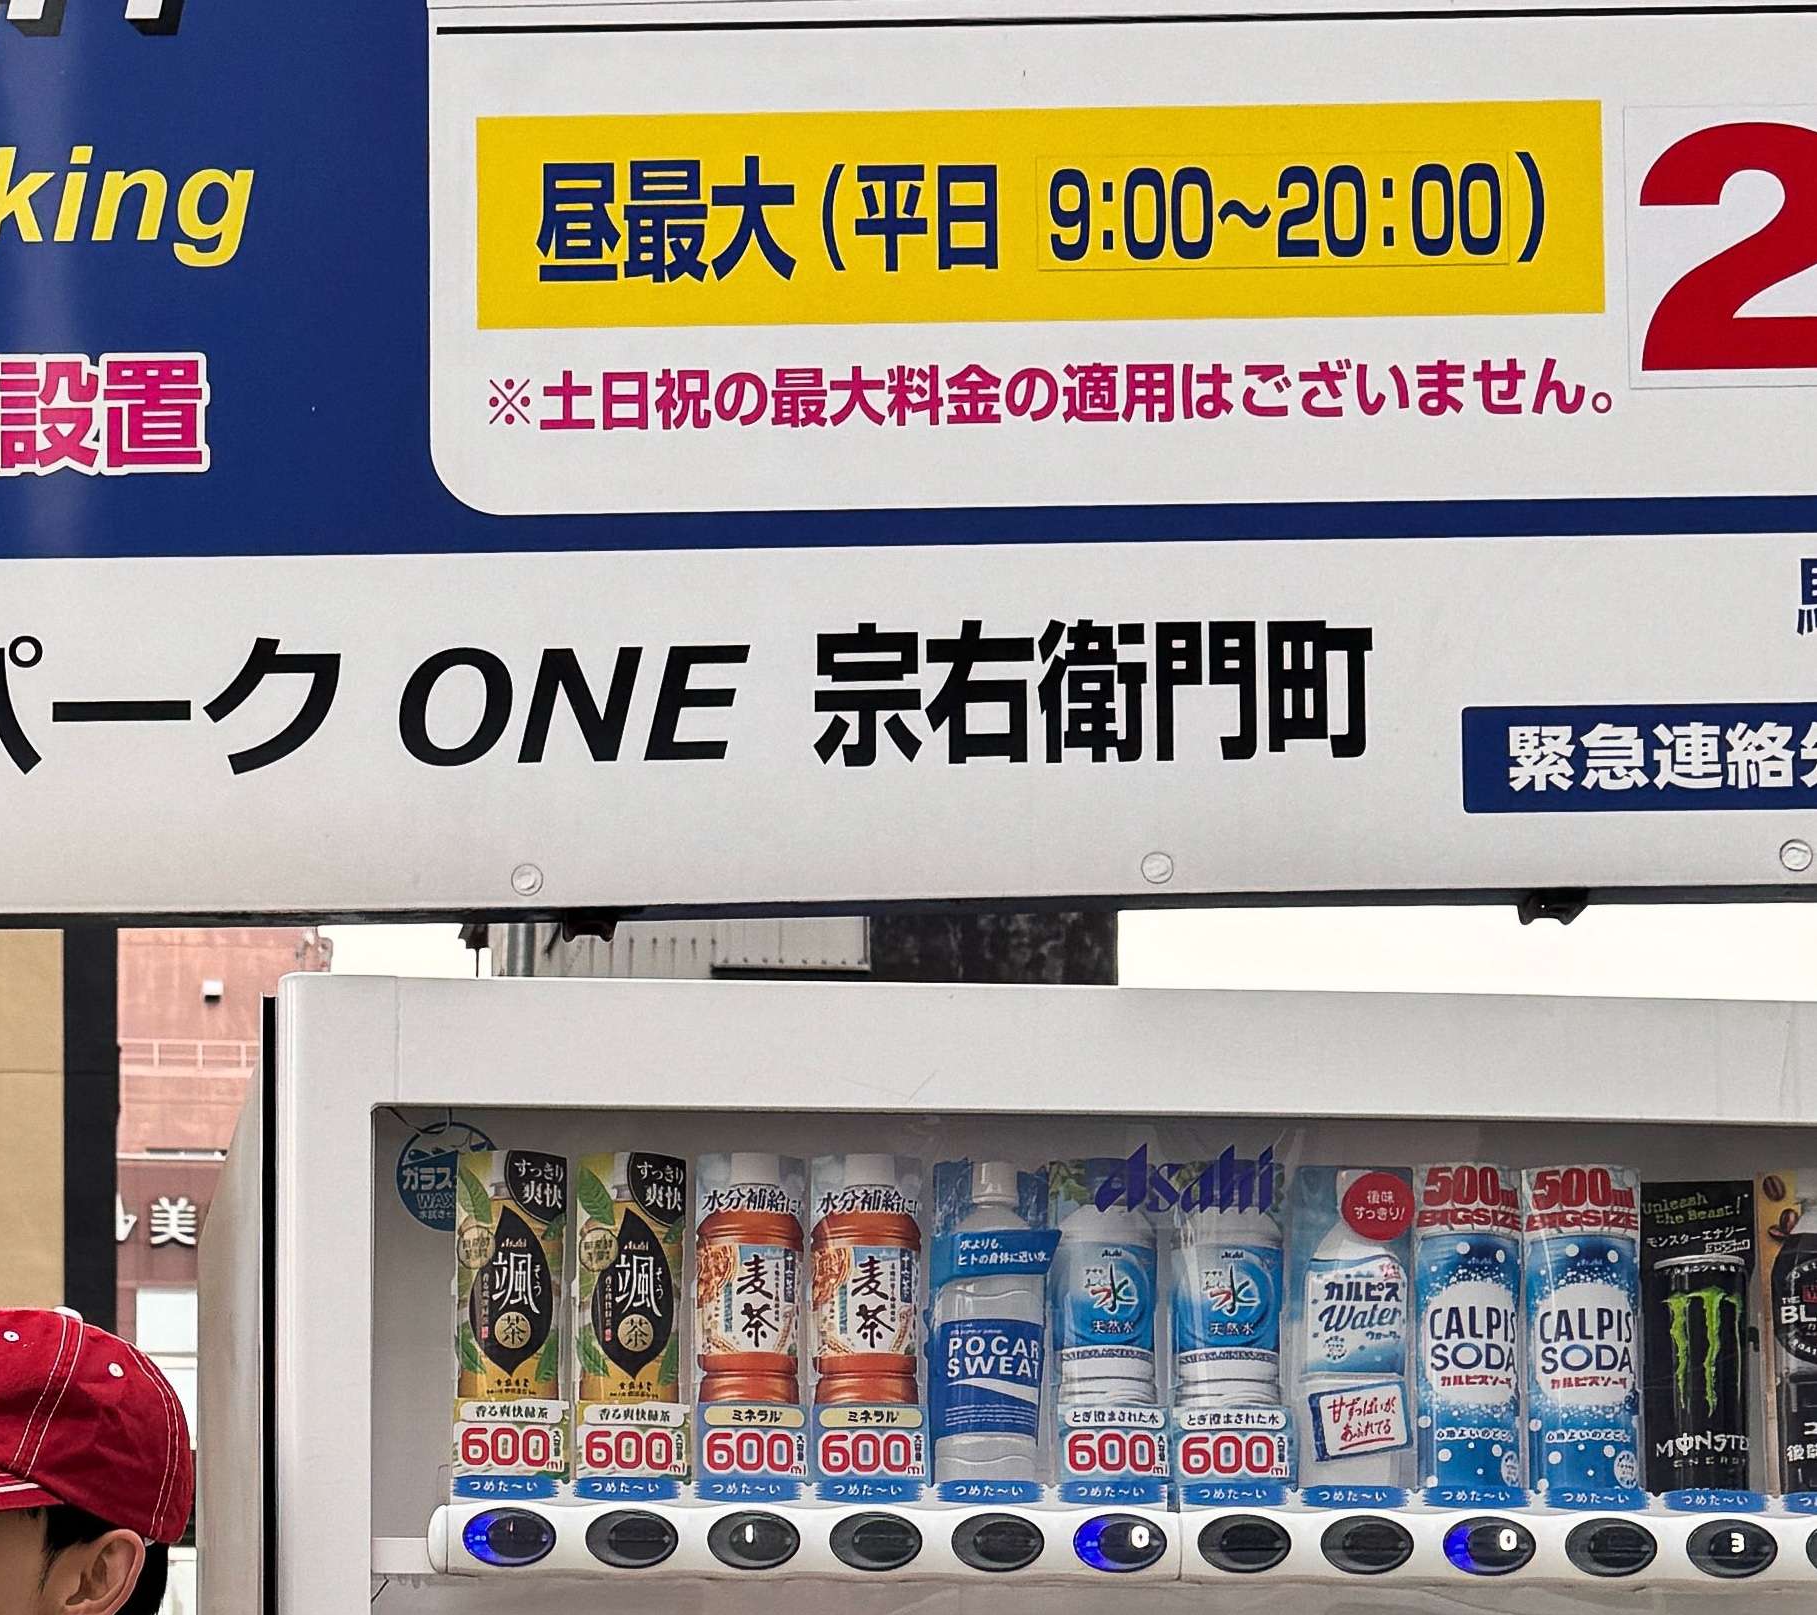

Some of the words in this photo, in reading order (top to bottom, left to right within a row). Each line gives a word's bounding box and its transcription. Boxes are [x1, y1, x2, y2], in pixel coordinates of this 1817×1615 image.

[398, 643, 750, 770] ONE
[812, 618, 1374, 769] 宗右衛門町
[1507, 721, 1817, 792] 緊急連絡
[1094, 1142, 1275, 1216] Asahi
[522, 1180, 563, 1209] 爽快
[644, 1183, 683, 1211] 爽快
[736, 1253, 779, 1348] 麦茶
[851, 1255, 896, 1349] 麦茶
[1325, 1281, 1402, 1302] カルピス
[502, 1314, 527, 1345] 茶
[624, 1318, 651, 1348] 茶
[1318, 1304, 1402, 1332] Water
[1430, 1306, 1516, 1344] CALPIS
[1539, 1307, 1633, 1344] CALPIS
[946, 1357, 1041, 1379] SWEAT
[1431, 1343, 1517, 1373] SODA
[1541, 1344, 1634, 1375] SODA
[732, 1408, 783, 1423] ミネラル
[847, 1410, 900, 1424] ミネラル
